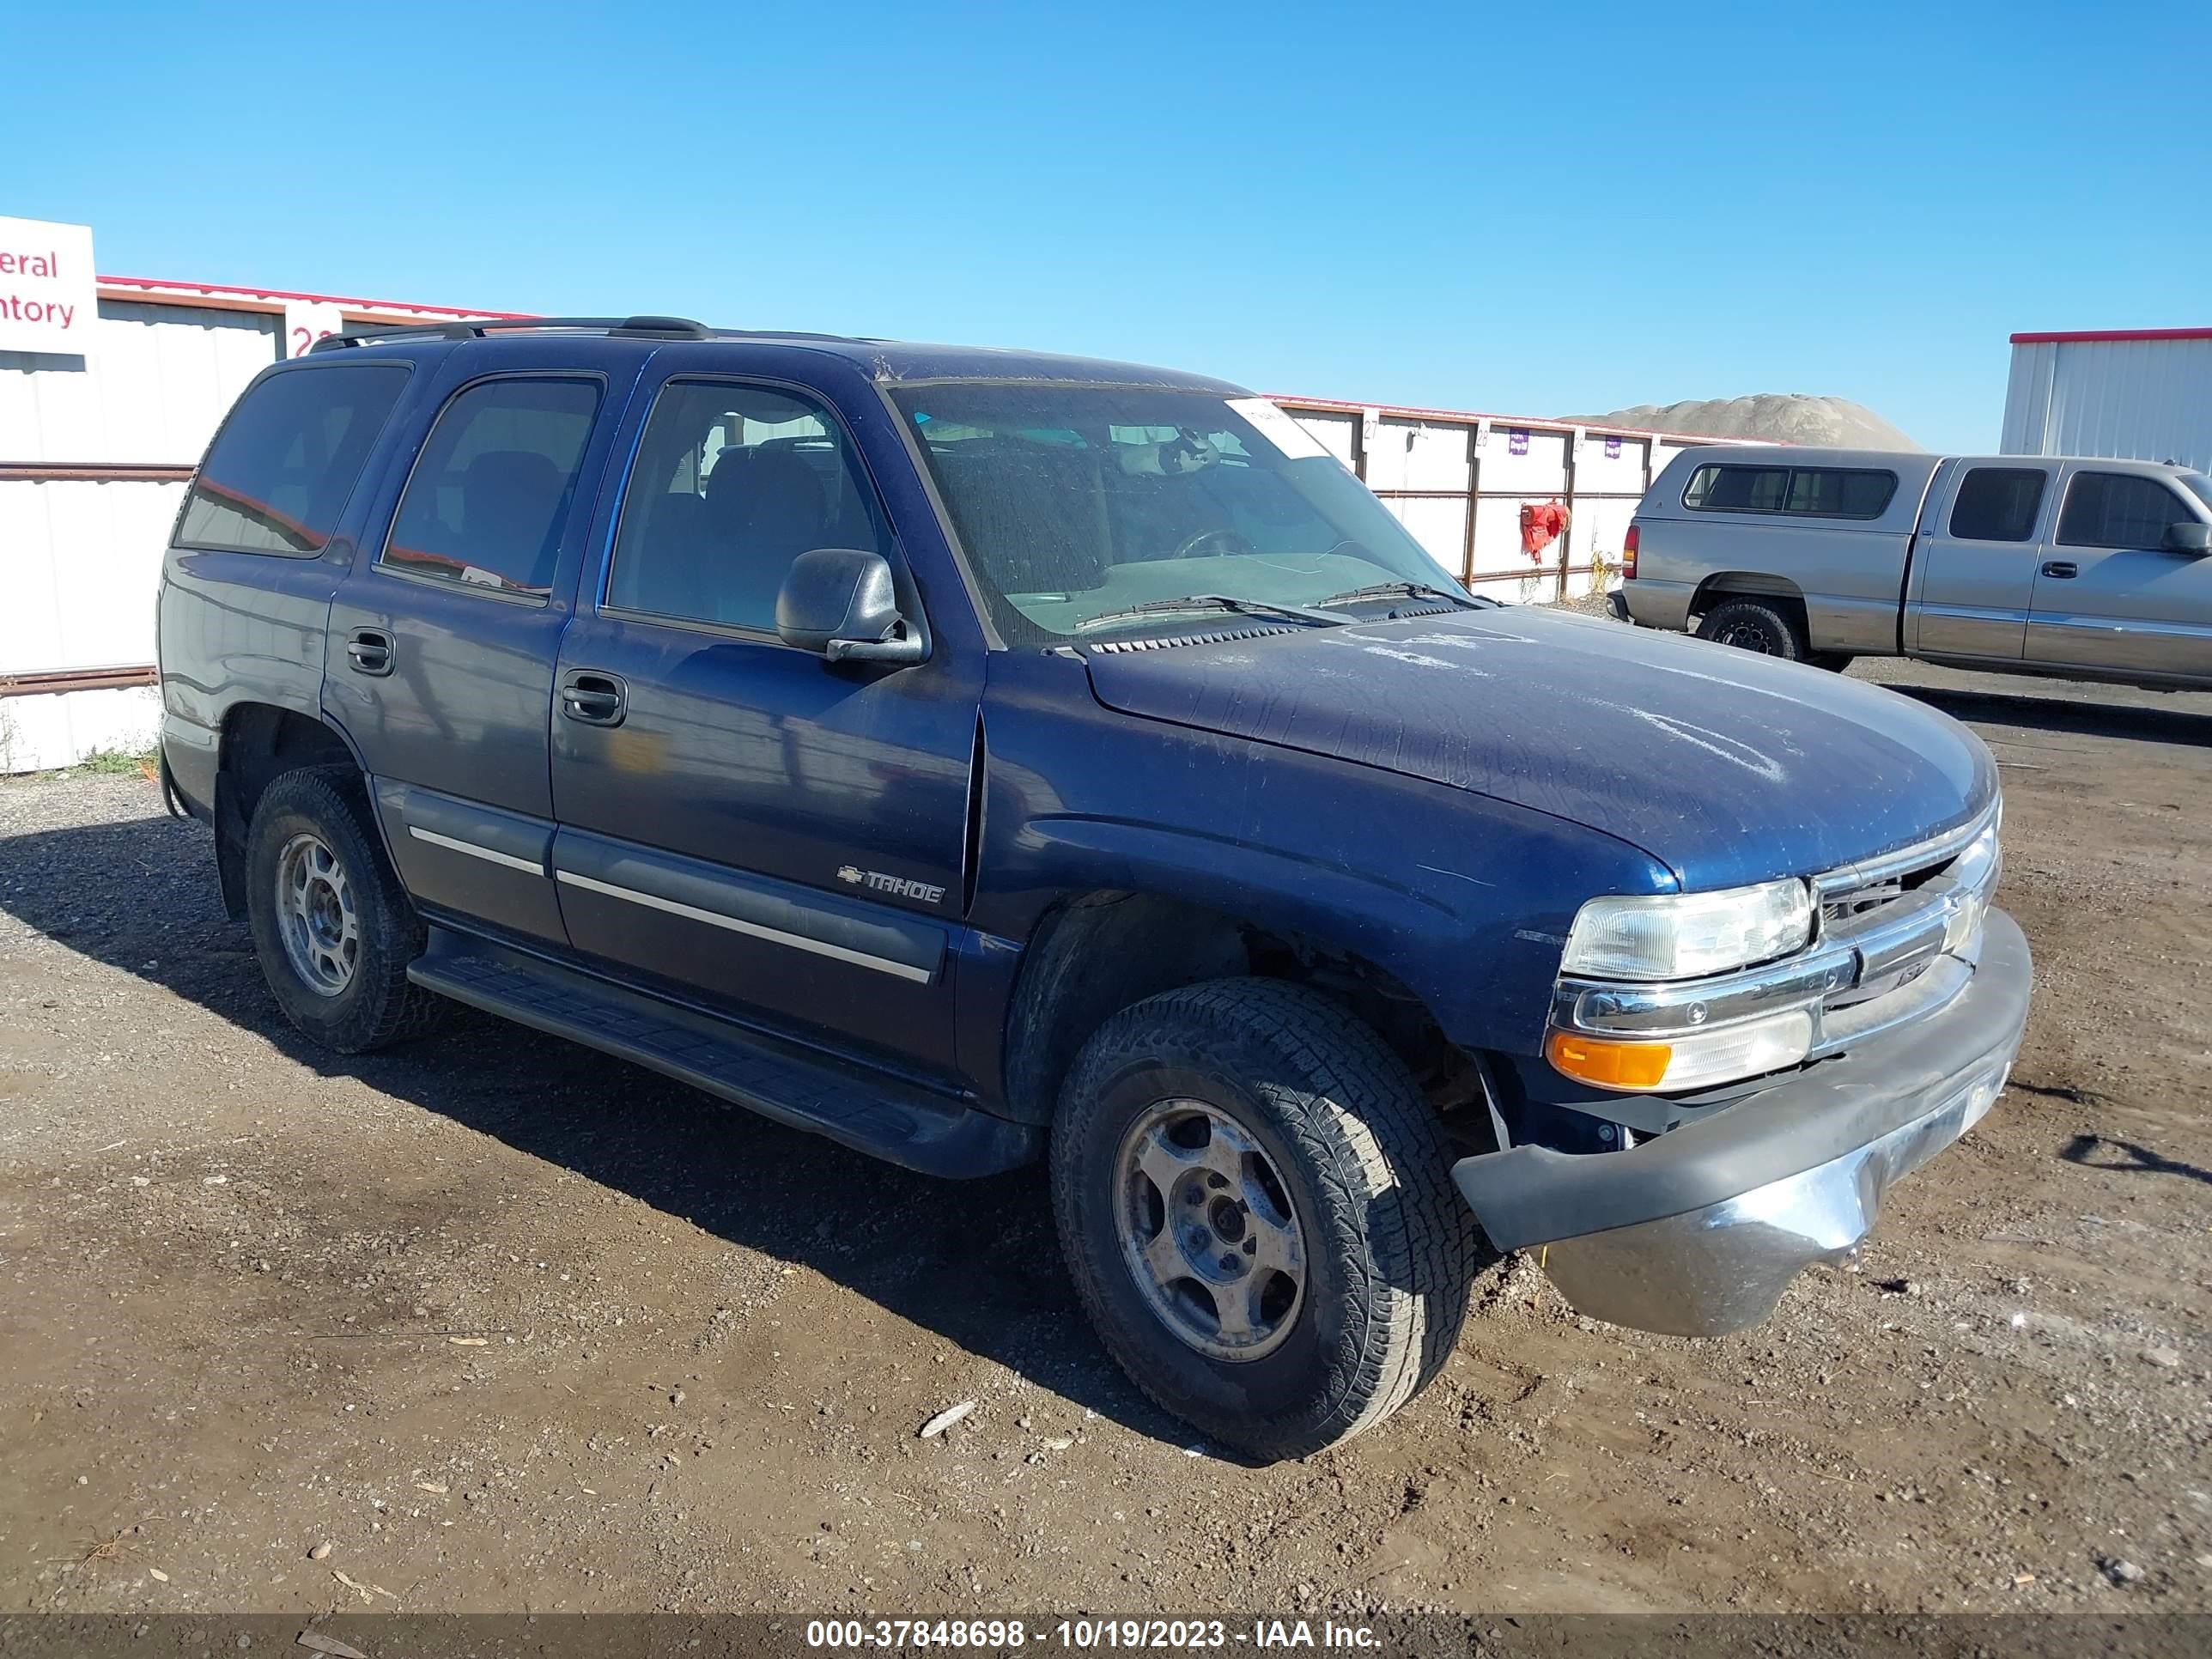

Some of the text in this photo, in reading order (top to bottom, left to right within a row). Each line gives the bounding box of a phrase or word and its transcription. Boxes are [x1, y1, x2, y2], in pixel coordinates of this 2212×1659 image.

[0, 252, 57, 277] eral
[293, 327, 332, 357] 2
[1364, 420, 1378, 440] 27
[1477, 429, 1488, 447] 28
[866, 871, 946, 903] TAHOE
